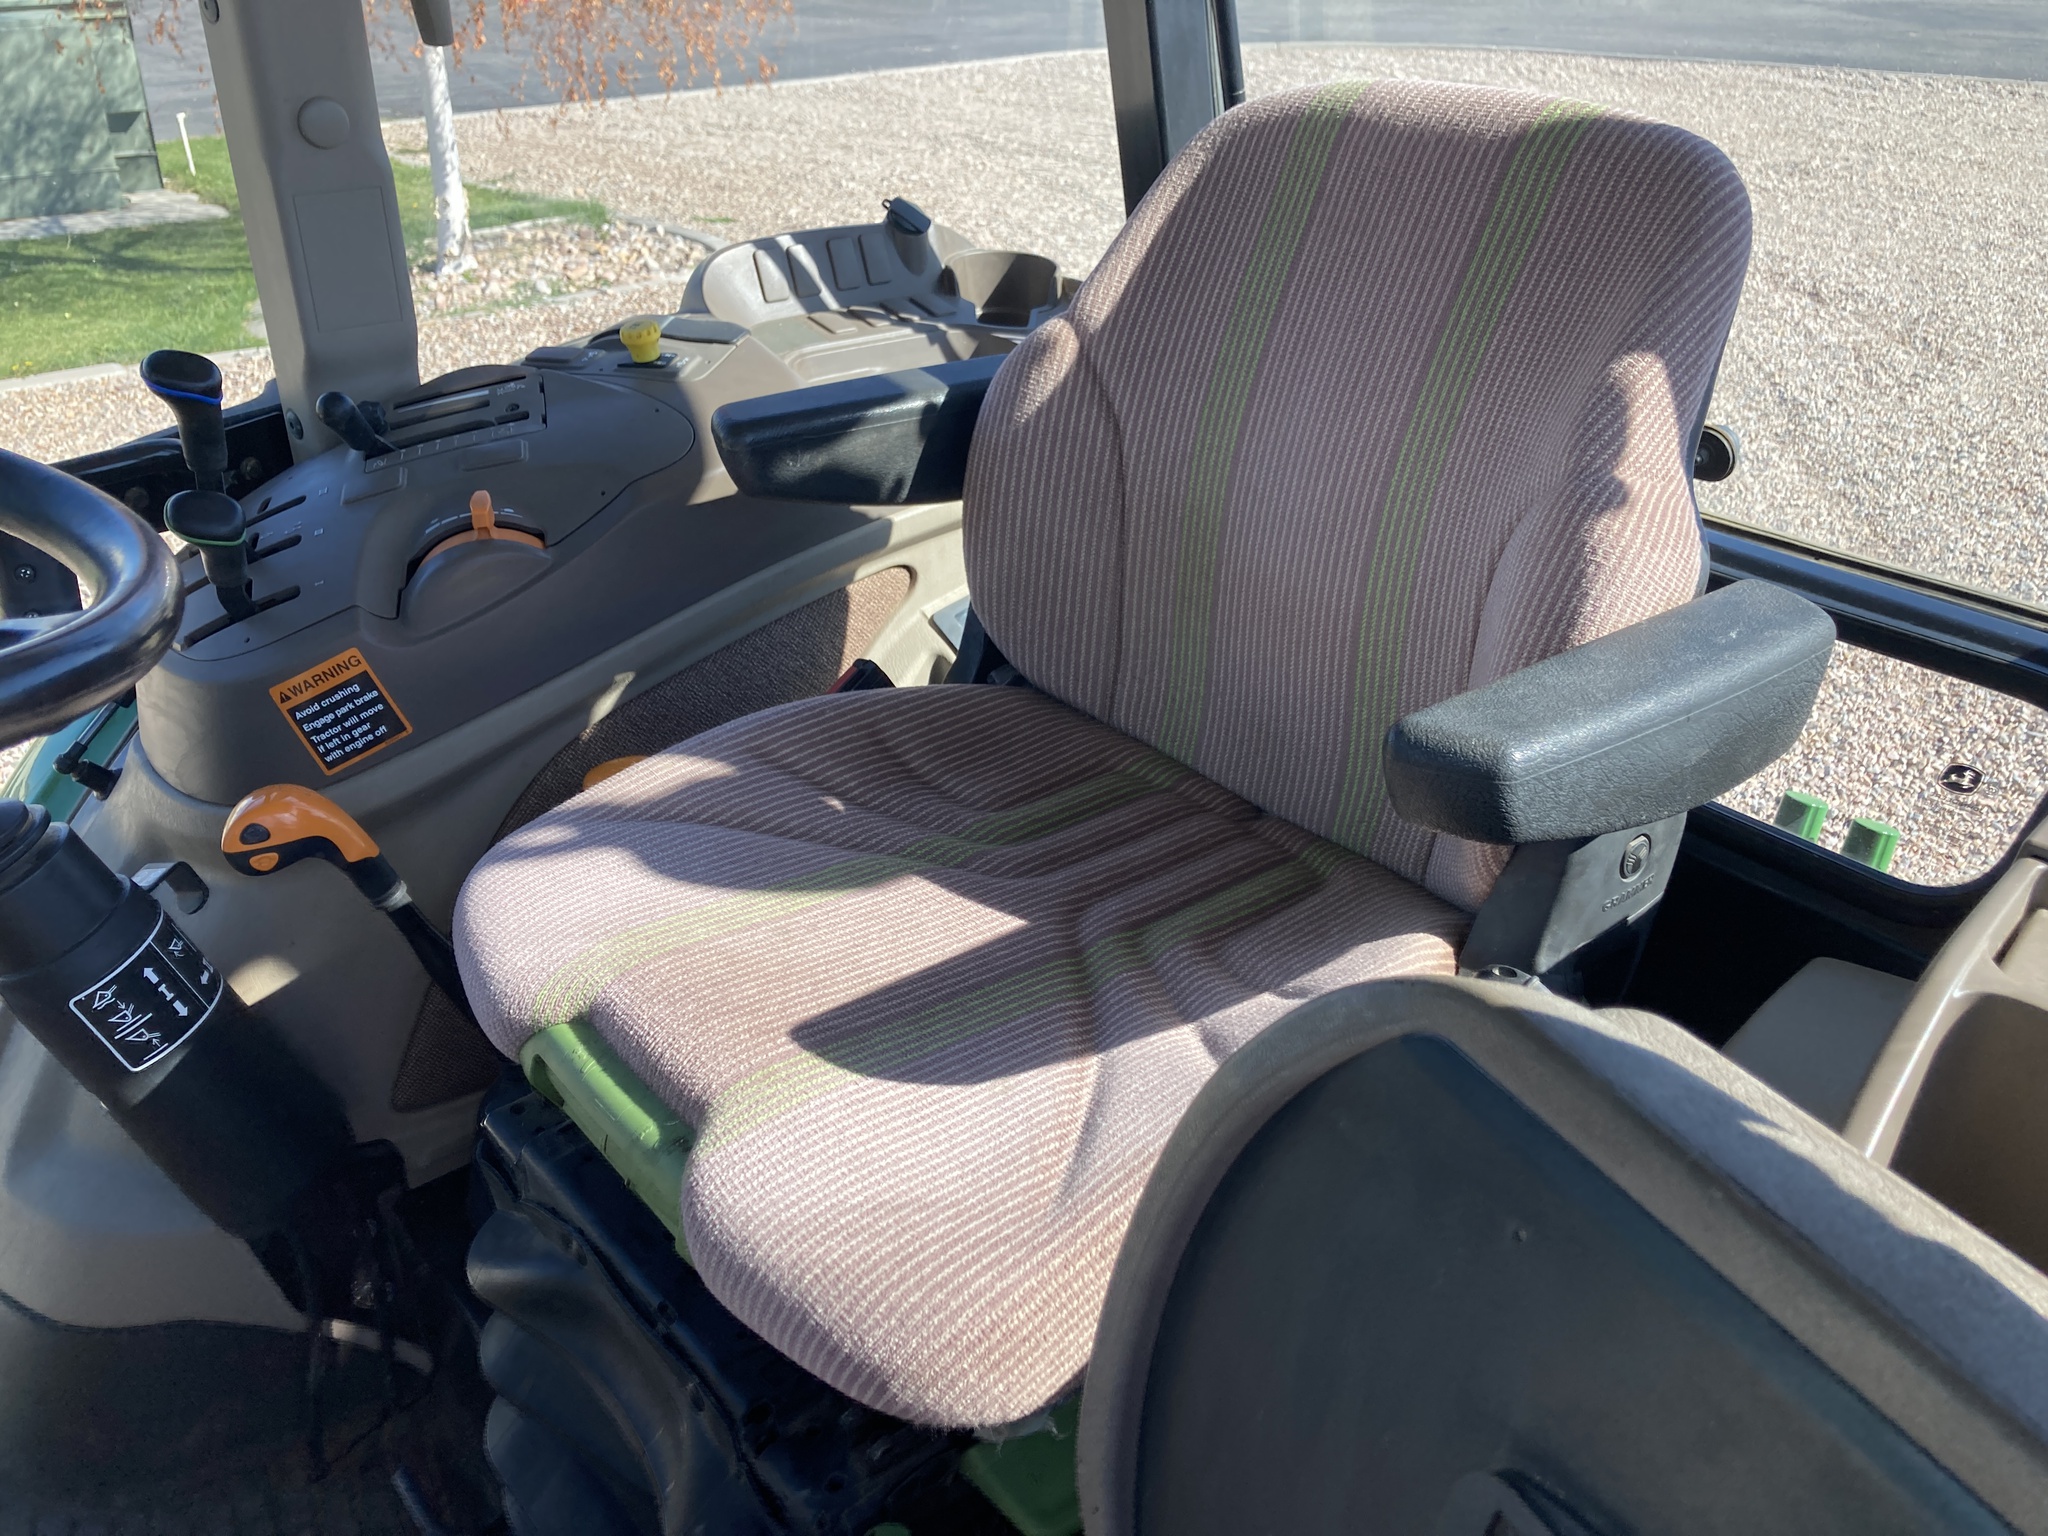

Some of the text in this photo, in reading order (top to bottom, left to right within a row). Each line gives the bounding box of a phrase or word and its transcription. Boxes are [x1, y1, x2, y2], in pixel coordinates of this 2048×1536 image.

[287, 655, 362, 697] WARNING
[295, 683, 361, 720] Avoid crushing
[302, 690, 379, 732] Engage park brake
[310, 703, 384, 744] Tractor will move
[324, 748, 344, 763] with
[344, 733, 375, 753] engine
[374, 724, 388, 737] off
[326, 737, 341, 750] left
[341, 732, 351, 742] in
[351, 722, 371, 738] gear
[1601, 872, 1655, 912] GRAMMER
